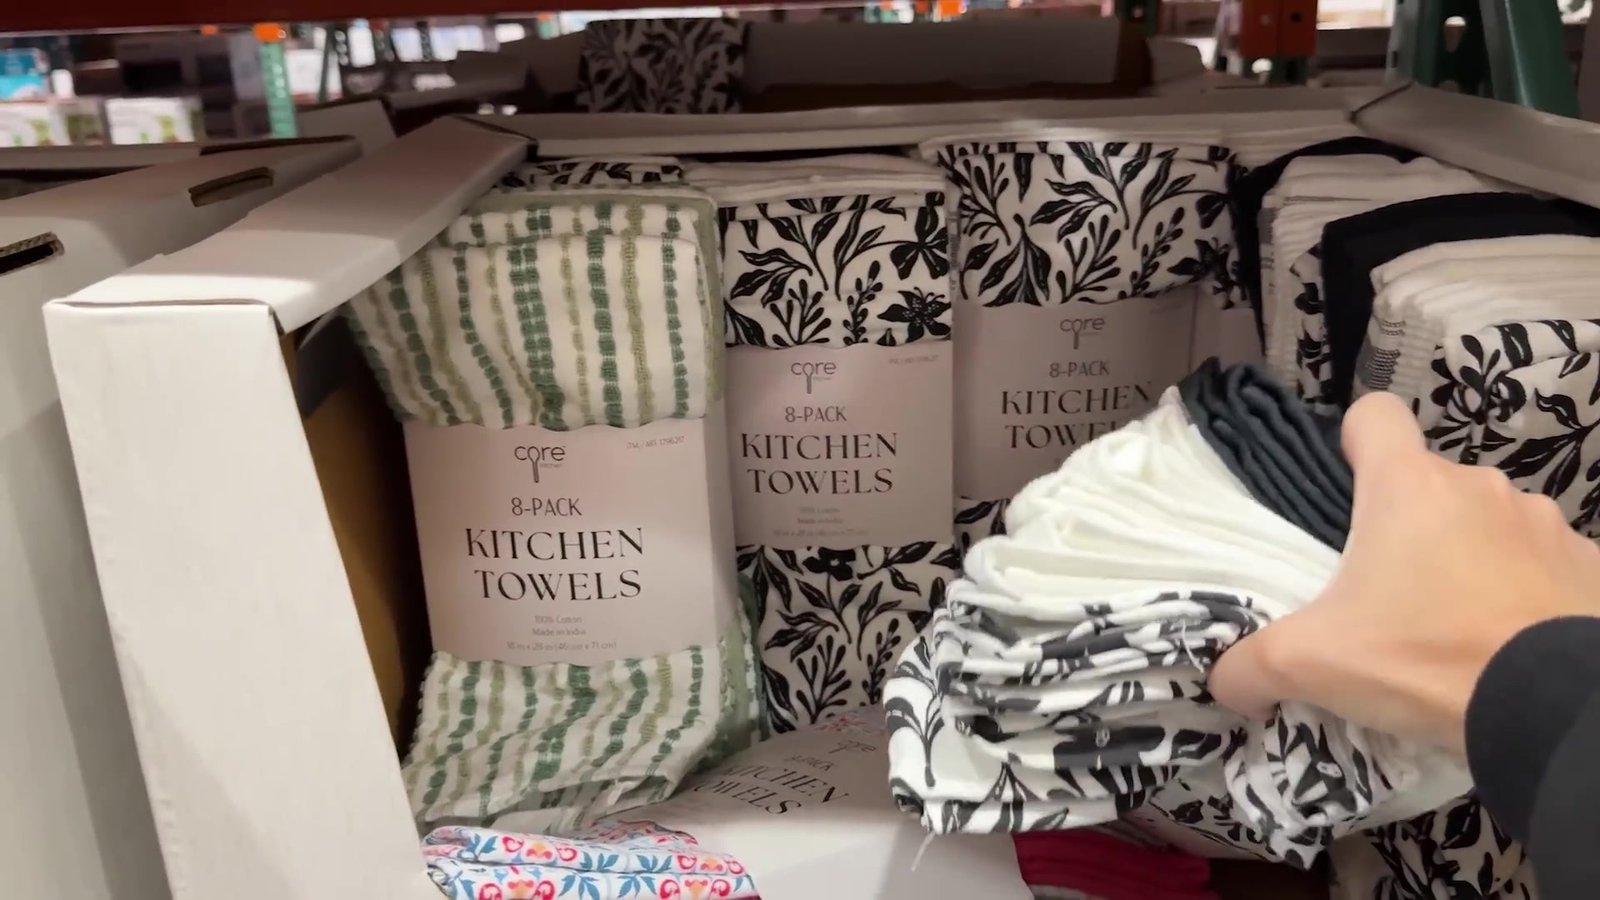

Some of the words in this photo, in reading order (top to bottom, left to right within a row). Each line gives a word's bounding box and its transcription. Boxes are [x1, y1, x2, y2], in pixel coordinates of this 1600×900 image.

[1049, 360, 1111, 378] 8-PACK
[1001, 381, 1153, 415] KITCHEN
[784, 406, 848, 423] 8-PACK
[741, 432, 898, 460] KITCHEN
[1005, 420, 1118, 449] TOWE
[747, 468, 894, 495] TOWELS
[511, 497, 583, 517] 8-PACK
[465, 527, 644, 561] KITCHEN
[474, 569, 642, 601] TOWELS
[692, 780, 803, 815] OWELS
